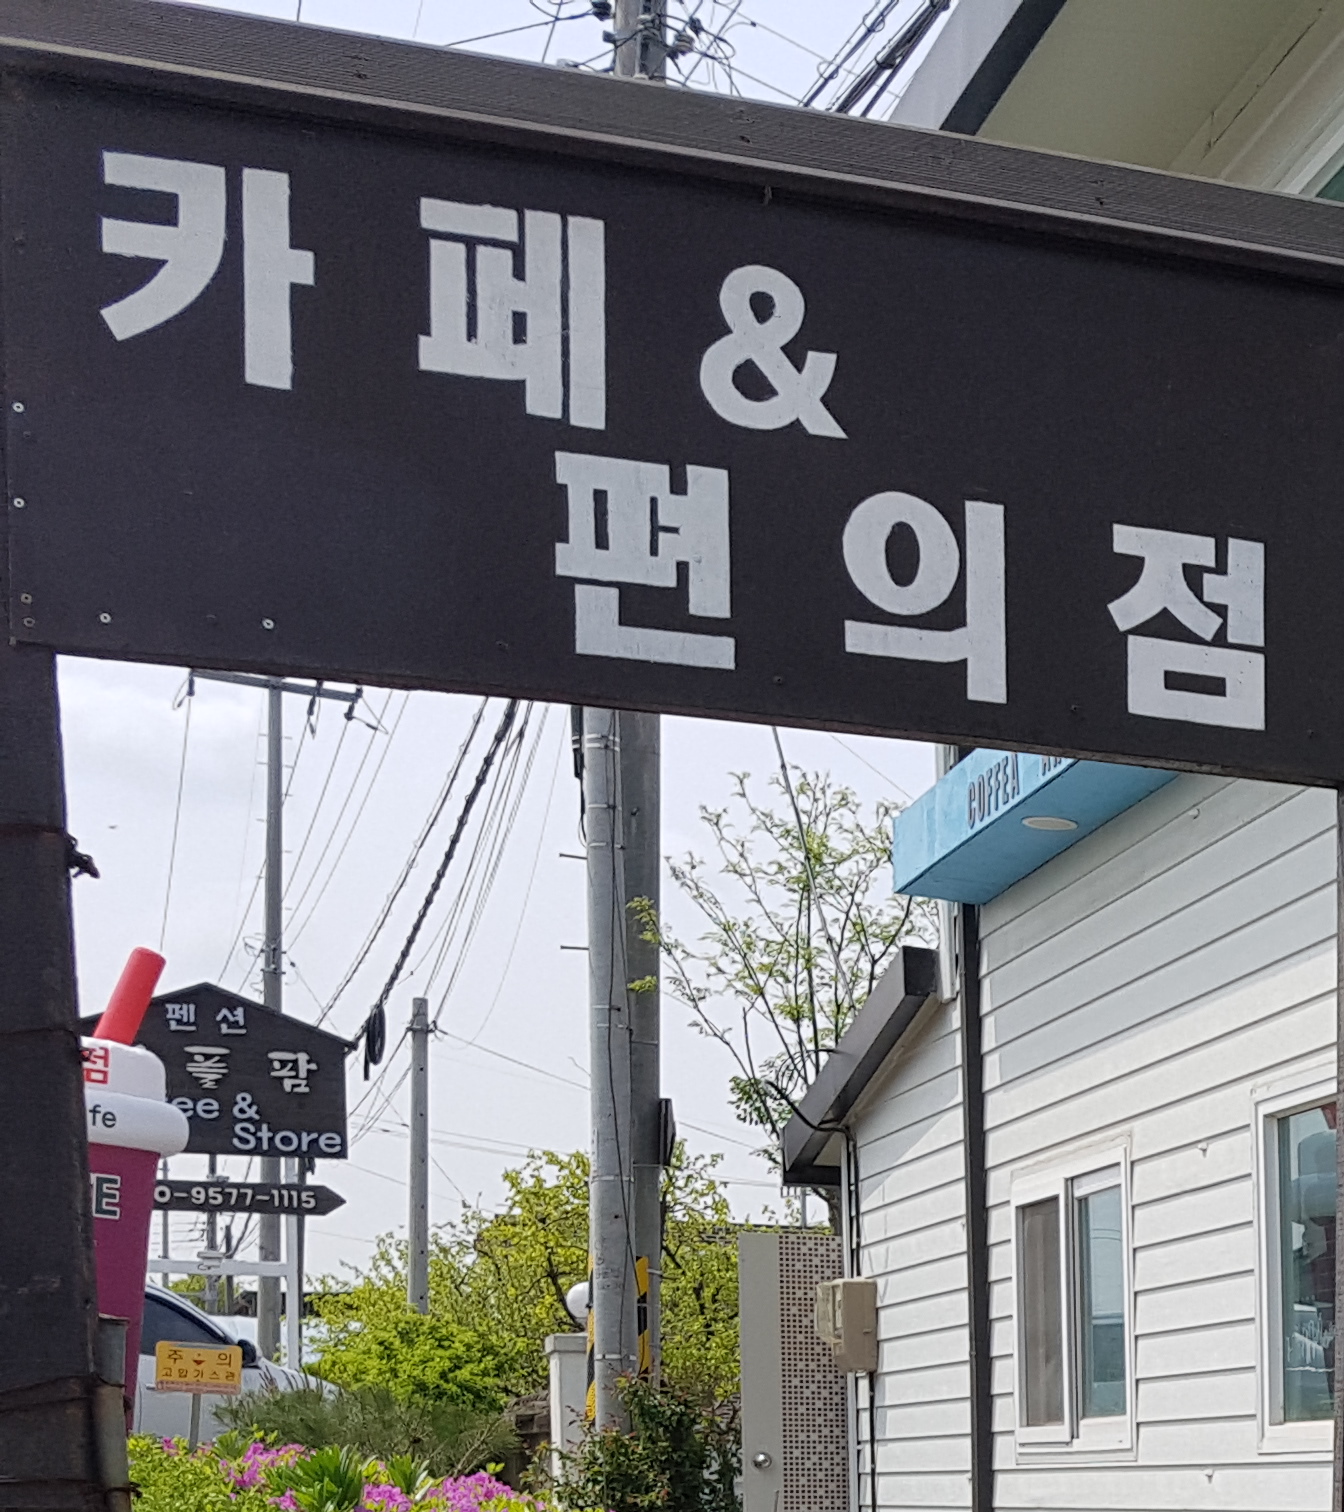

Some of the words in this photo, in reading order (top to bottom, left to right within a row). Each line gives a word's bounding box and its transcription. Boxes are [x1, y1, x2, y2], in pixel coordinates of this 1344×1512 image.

[967, 750, 1020, 830] COFFEA
[166, 1095, 220, 1119] ee
[232, 1092, 260, 1121] &
[232, 1123, 342, 1152] Store
